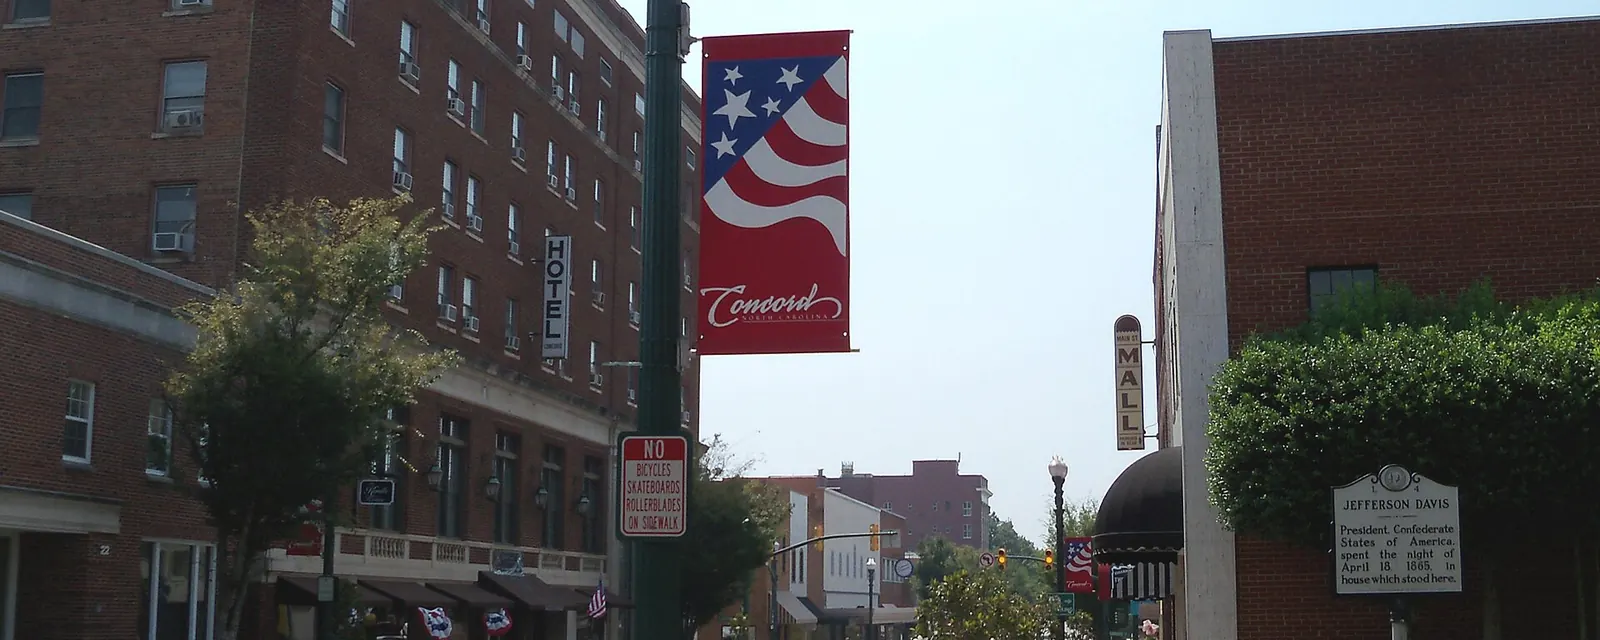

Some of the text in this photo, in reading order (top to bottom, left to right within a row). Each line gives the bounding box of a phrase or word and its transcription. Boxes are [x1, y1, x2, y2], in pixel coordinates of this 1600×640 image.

[546, 240, 564, 338] HOTEL
[700, 283, 842, 327] Concord
[1118, 347, 1140, 431] MALL
[644, 439, 665, 459] NO
[636, 463, 671, 477] BICYCLES
[627, 480, 680, 494] SKATEBOARDS
[626, 498, 681, 512] ROLLERBLADES
[1343, 499, 1450, 511] JEFFERSON DAVIS
[629, 515, 679, 530] ON SIDEWALK
[1393, 524, 1455, 534] Confederate
[1340, 537, 1376, 547] States
[1386, 537, 1398, 546] of
[1341, 548, 1455, 561] spent the night of
[1341, 562, 1369, 573] April
[1446, 562, 1456, 571] in
[1341, 573, 1457, 584] house which stood here.
